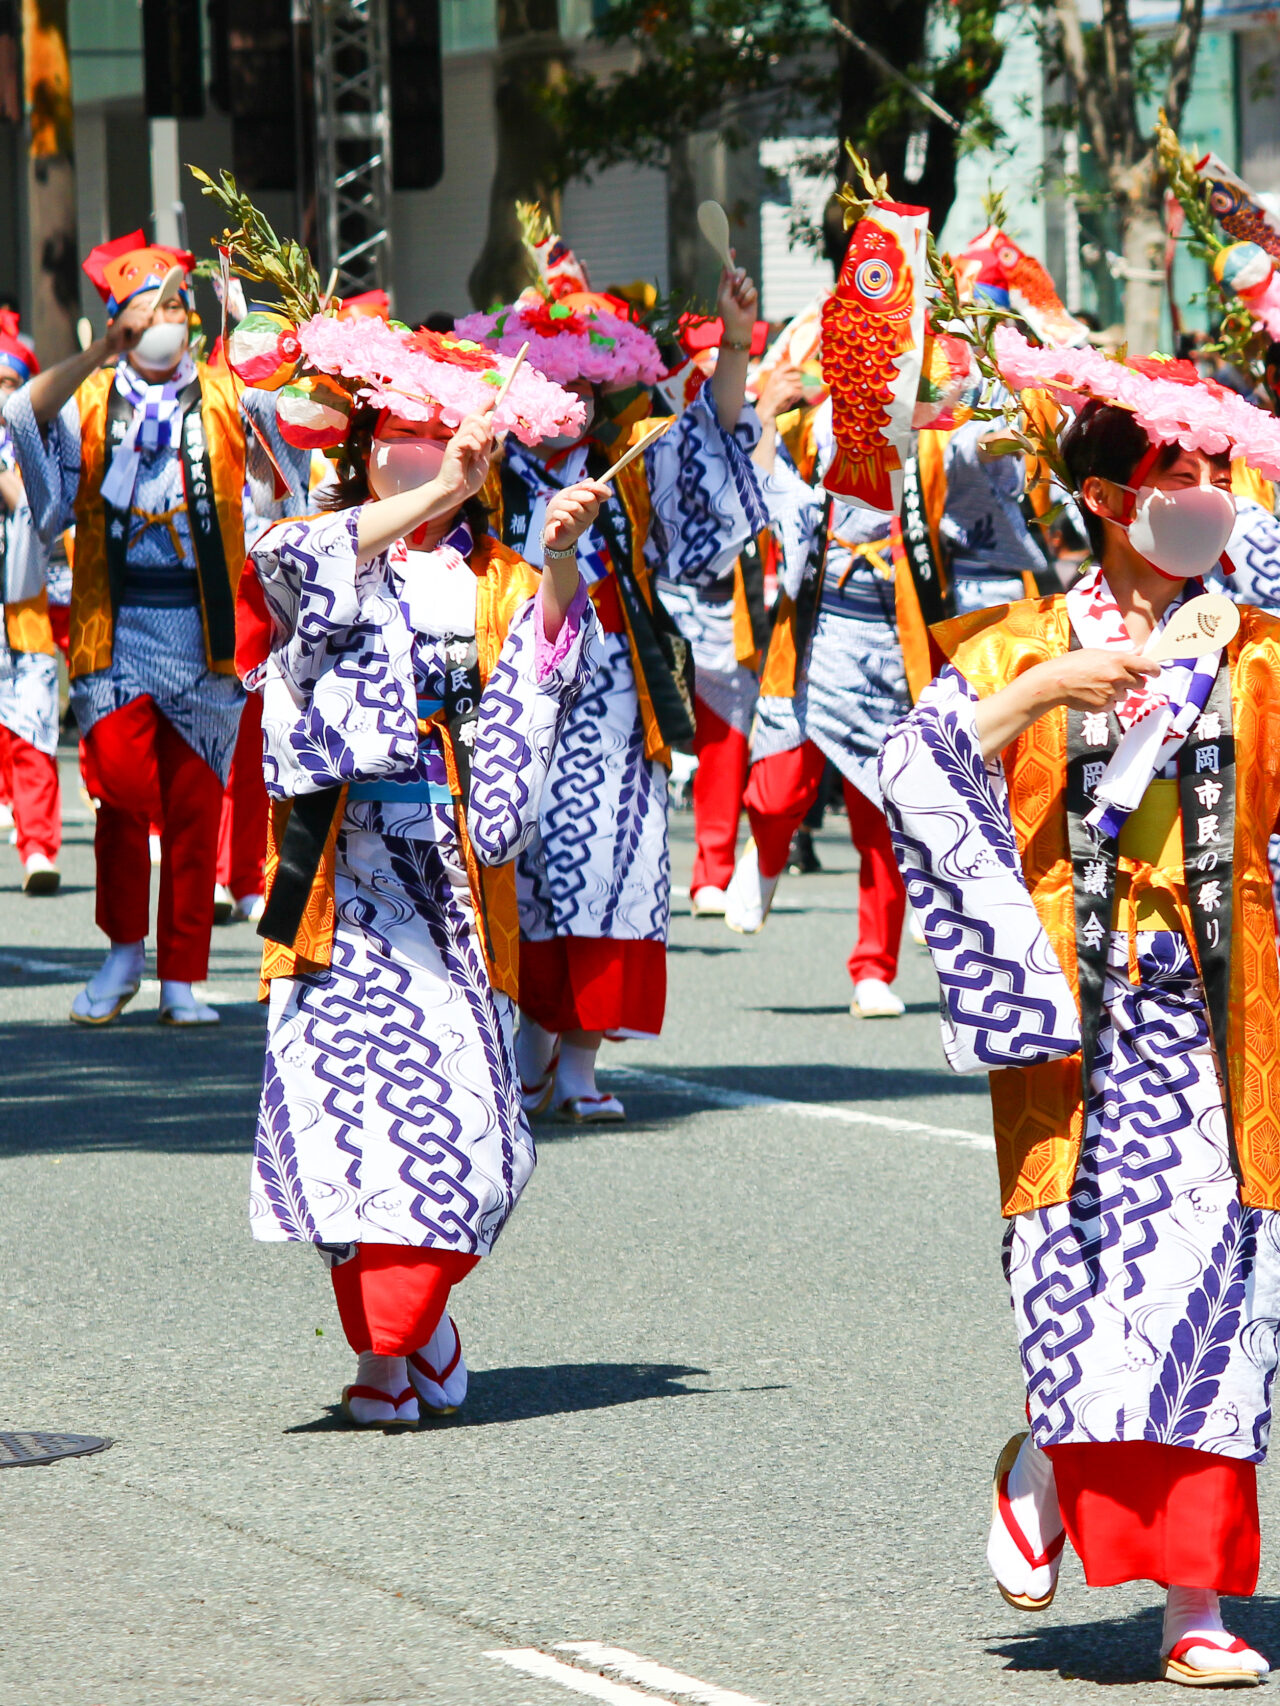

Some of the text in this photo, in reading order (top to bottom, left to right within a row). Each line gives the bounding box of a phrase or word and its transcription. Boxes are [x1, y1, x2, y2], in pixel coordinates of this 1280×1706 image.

[1081, 711, 1109, 952] 福岡議会
[1193, 711, 1224, 950] 福岡市民の祭り
